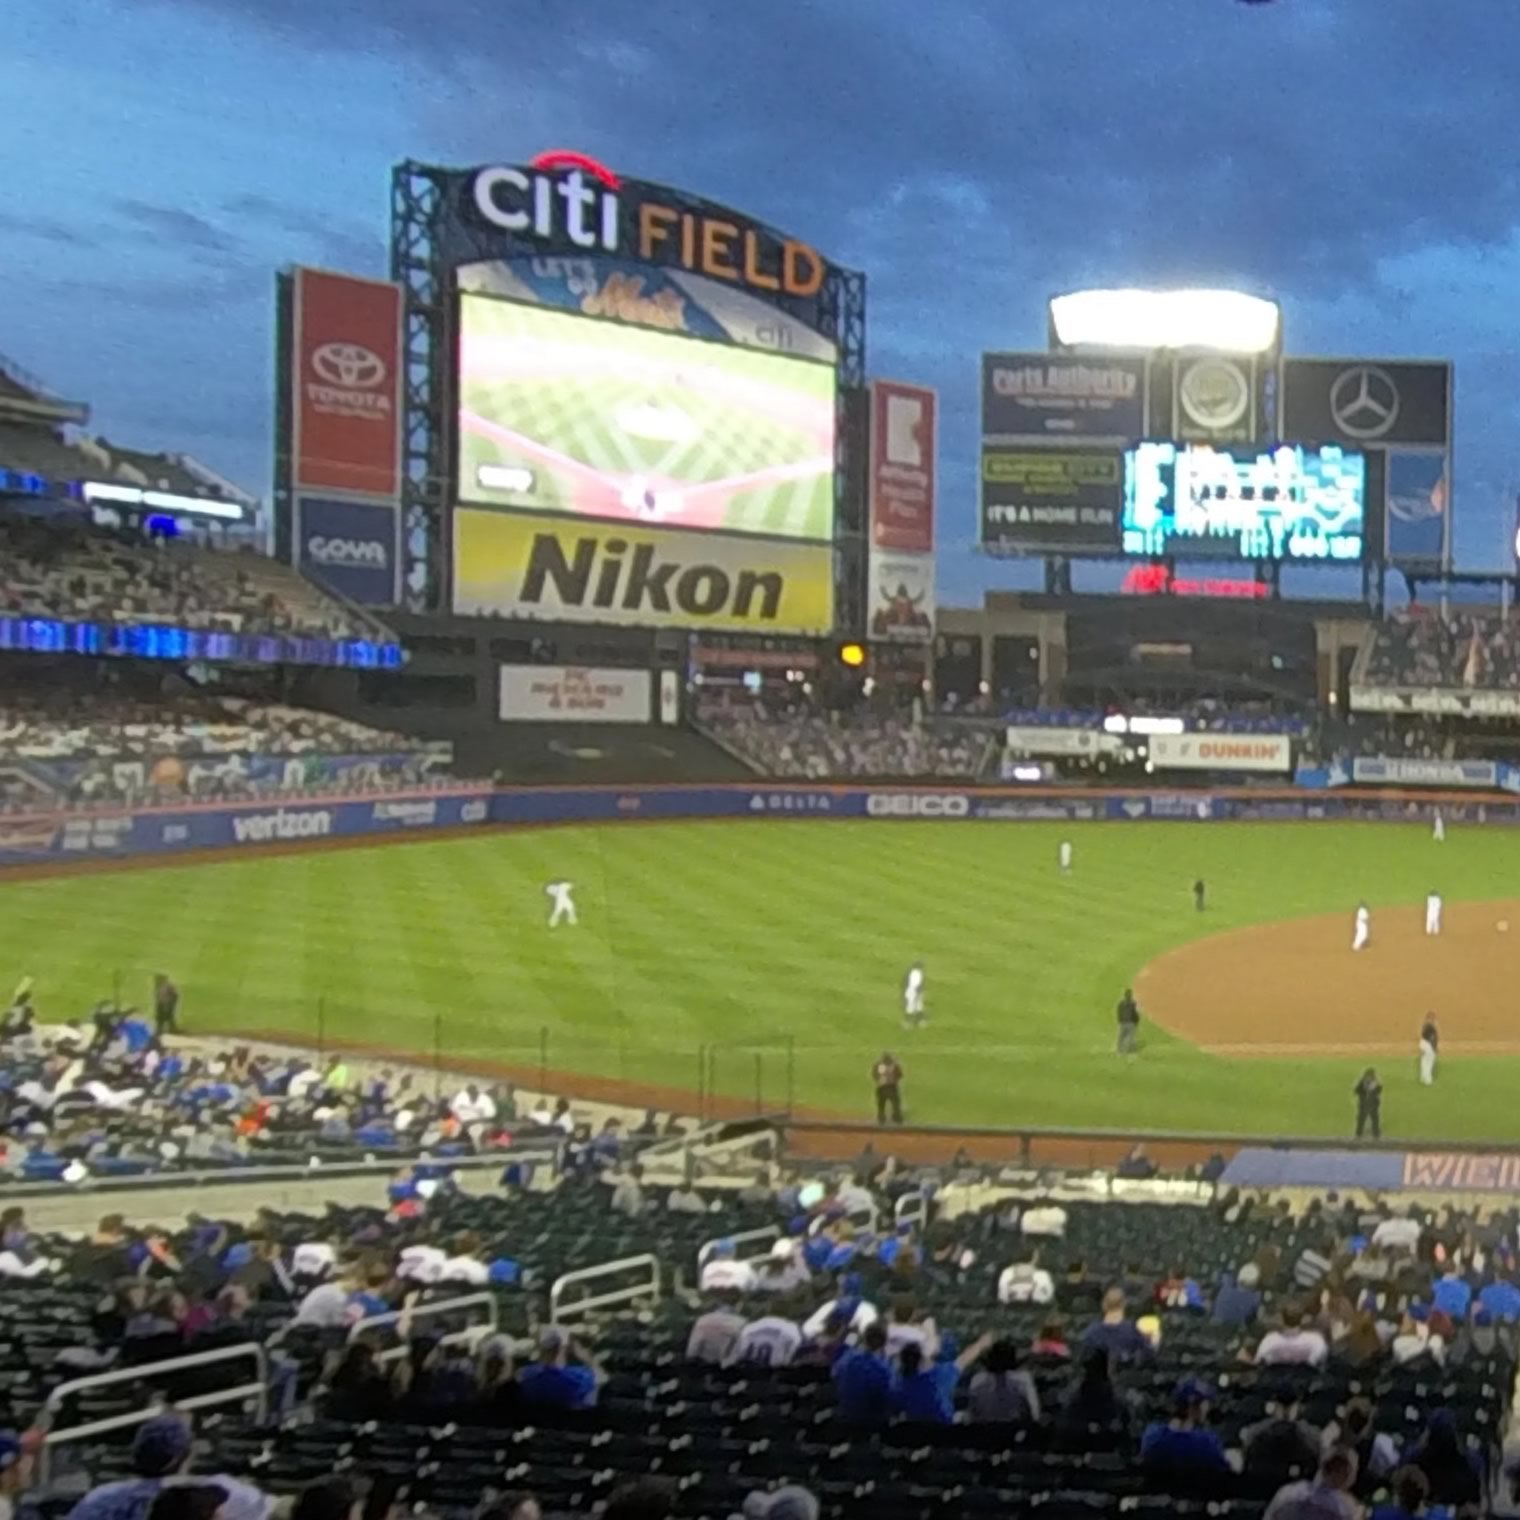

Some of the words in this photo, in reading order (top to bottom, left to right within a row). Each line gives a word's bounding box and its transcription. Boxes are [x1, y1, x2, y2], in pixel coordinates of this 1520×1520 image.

[474, 166, 618, 252] citi
[638, 203, 826, 297] FIELD
[307, 383, 391, 411] TOYOTA
[519, 531, 784, 619] Nikon
[1199, 742, 1281, 761] DUNKIN'
[768, 795, 831, 811] DELTA
[867, 794, 969, 816] GEICO
[233, 808, 331, 842] verizon
